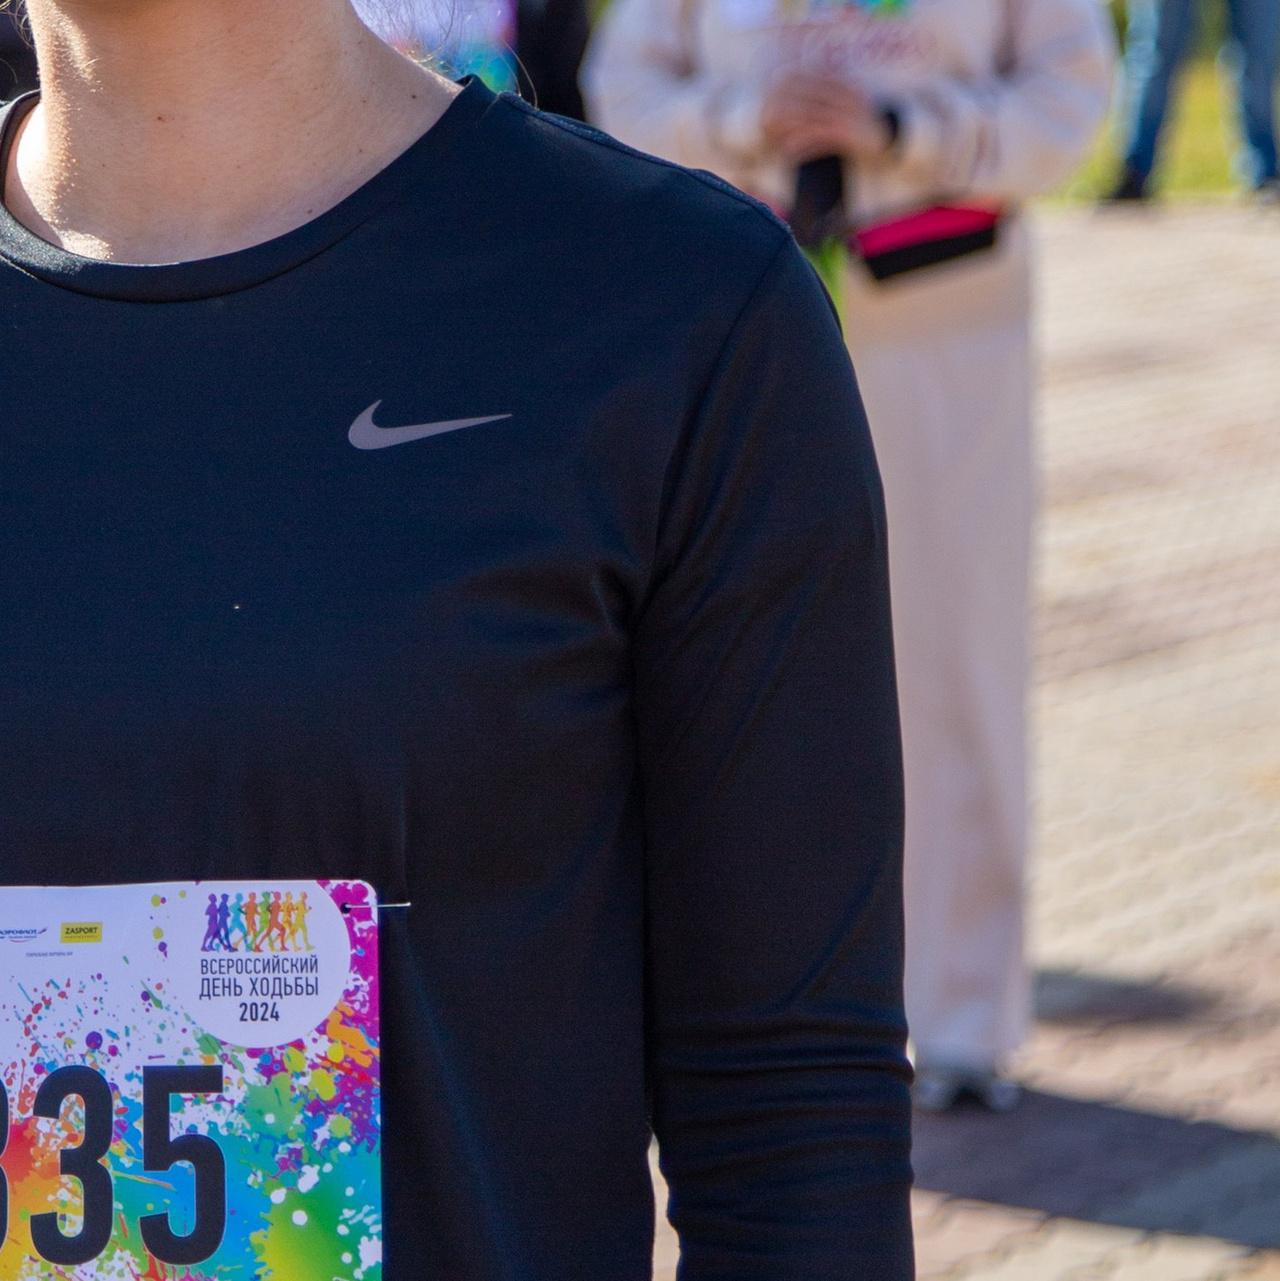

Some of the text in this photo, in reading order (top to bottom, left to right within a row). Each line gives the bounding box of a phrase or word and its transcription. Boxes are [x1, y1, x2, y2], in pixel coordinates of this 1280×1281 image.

[65, 927, 98, 935] ZASPORT
[200, 955, 318, 975] ВСЕРОССИЙСКИЙ
[199, 976, 319, 1000] ДЕНЬ ХОДЬБЫ
[239, 1002, 280, 1022] 2024
